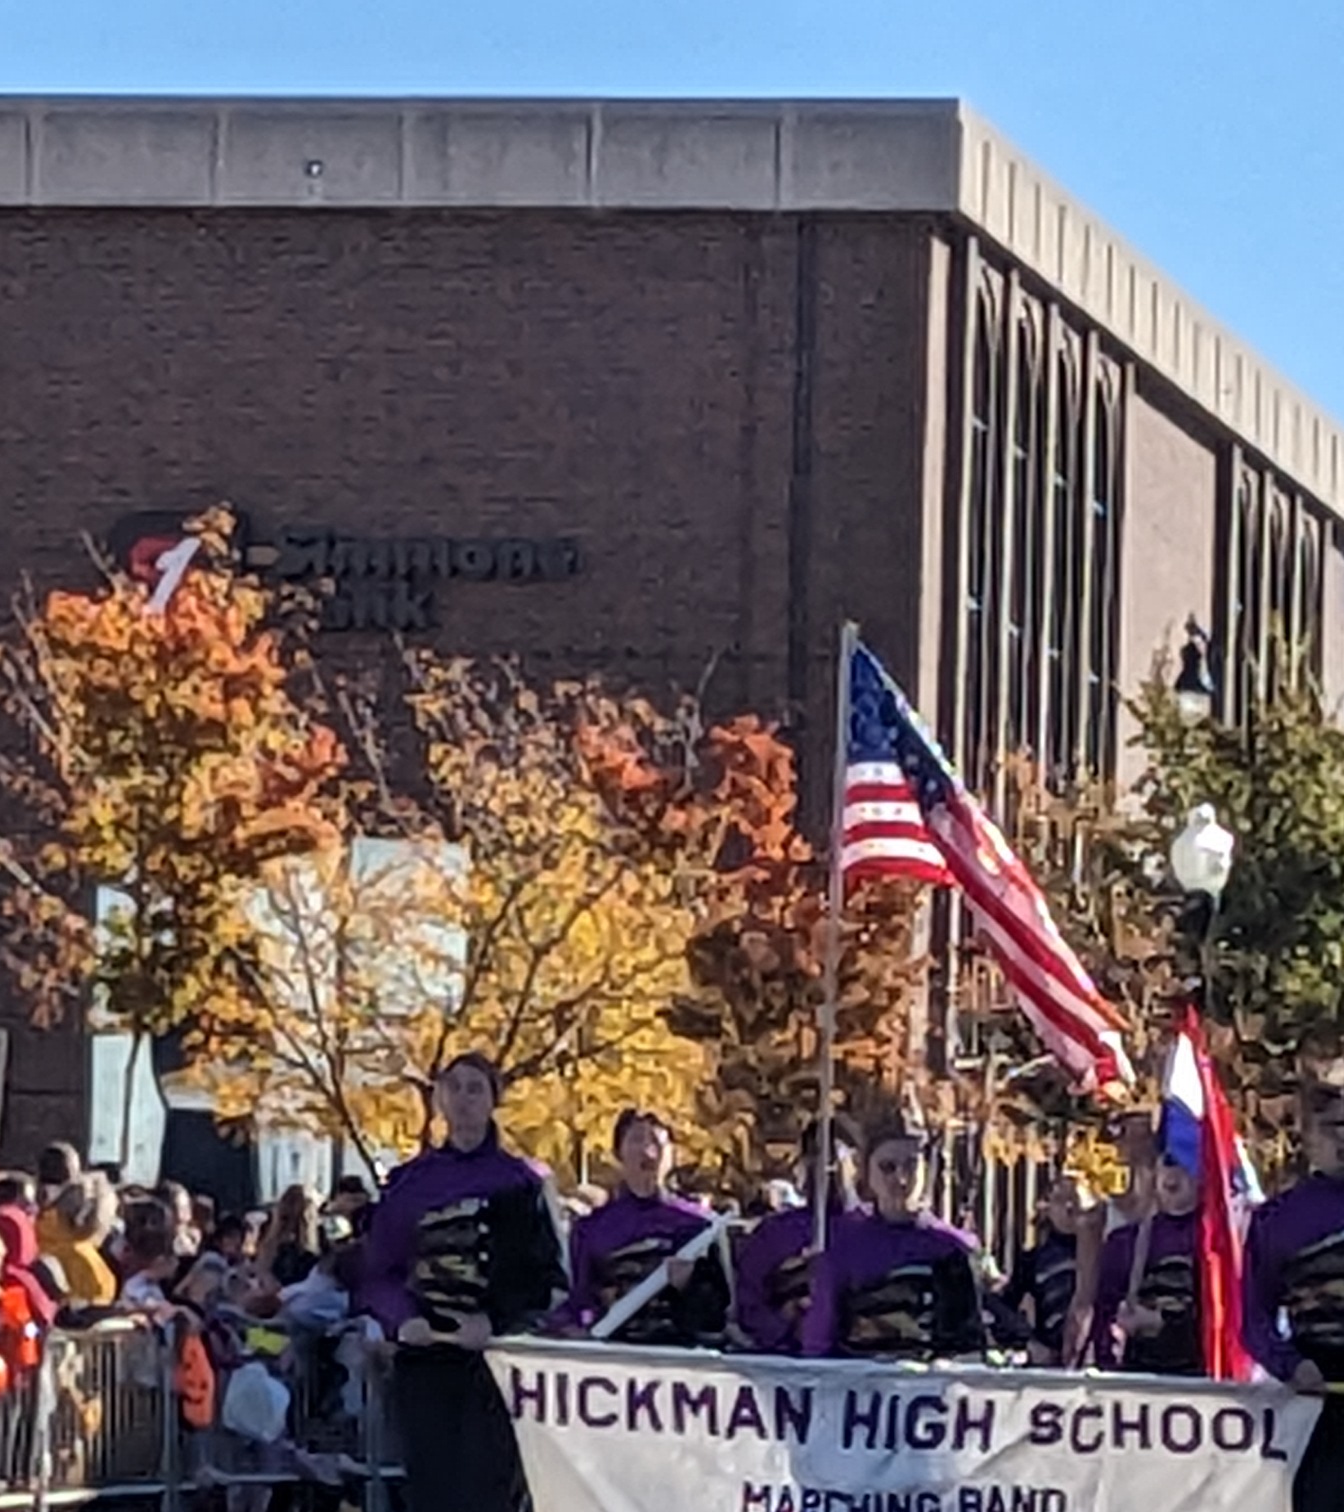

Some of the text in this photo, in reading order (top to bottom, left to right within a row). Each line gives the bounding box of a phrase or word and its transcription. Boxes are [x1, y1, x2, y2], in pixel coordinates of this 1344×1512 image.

[509, 1366, 1289, 1461] HICKMAN HIGH SCHOOL
